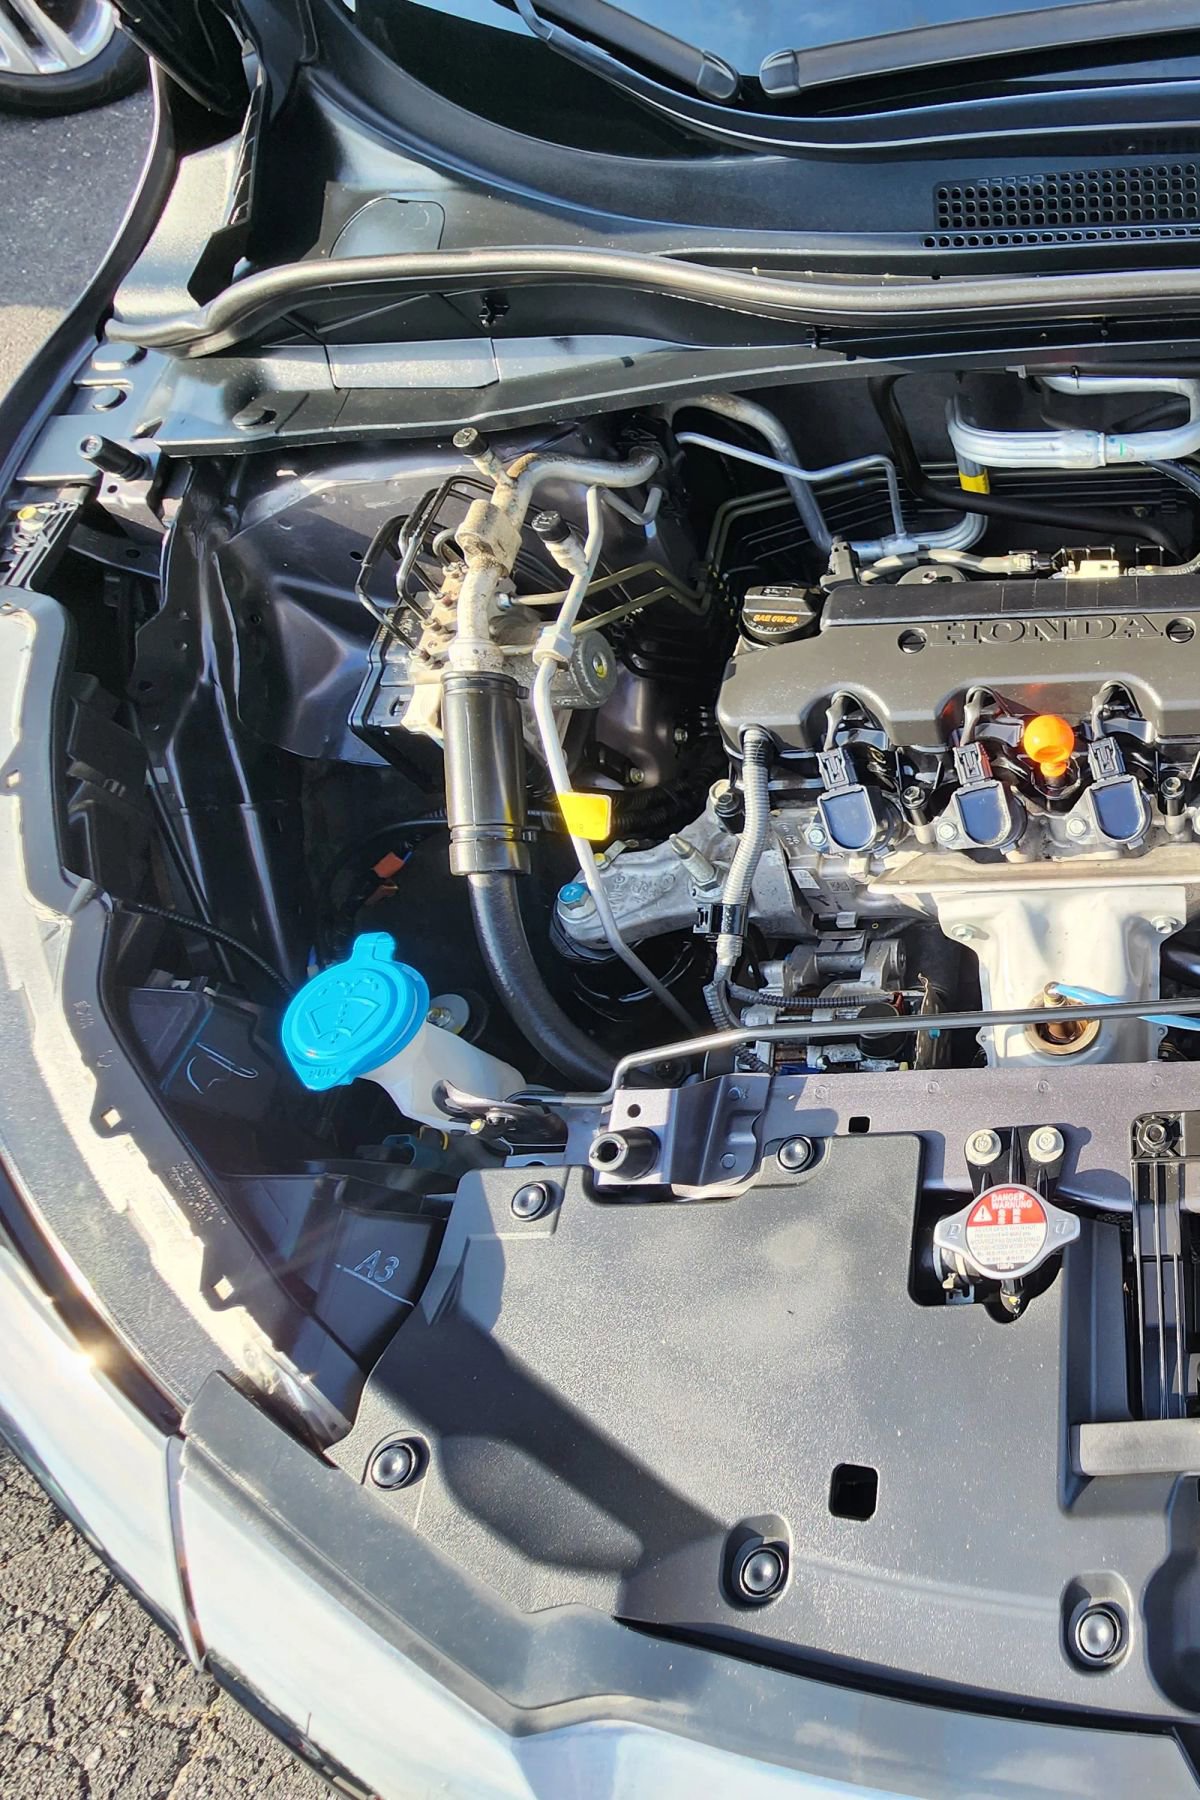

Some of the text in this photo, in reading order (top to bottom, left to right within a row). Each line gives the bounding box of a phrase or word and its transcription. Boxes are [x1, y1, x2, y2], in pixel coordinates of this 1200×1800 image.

[753, 614, 798, 623] SAE 0W-20
[929, 614, 1163, 646] HONDA
[991, 1192, 1025, 1201] DANGER
[991, 1200, 1033, 1209] WARNUNG
[354, 1249, 400, 1283] A3
